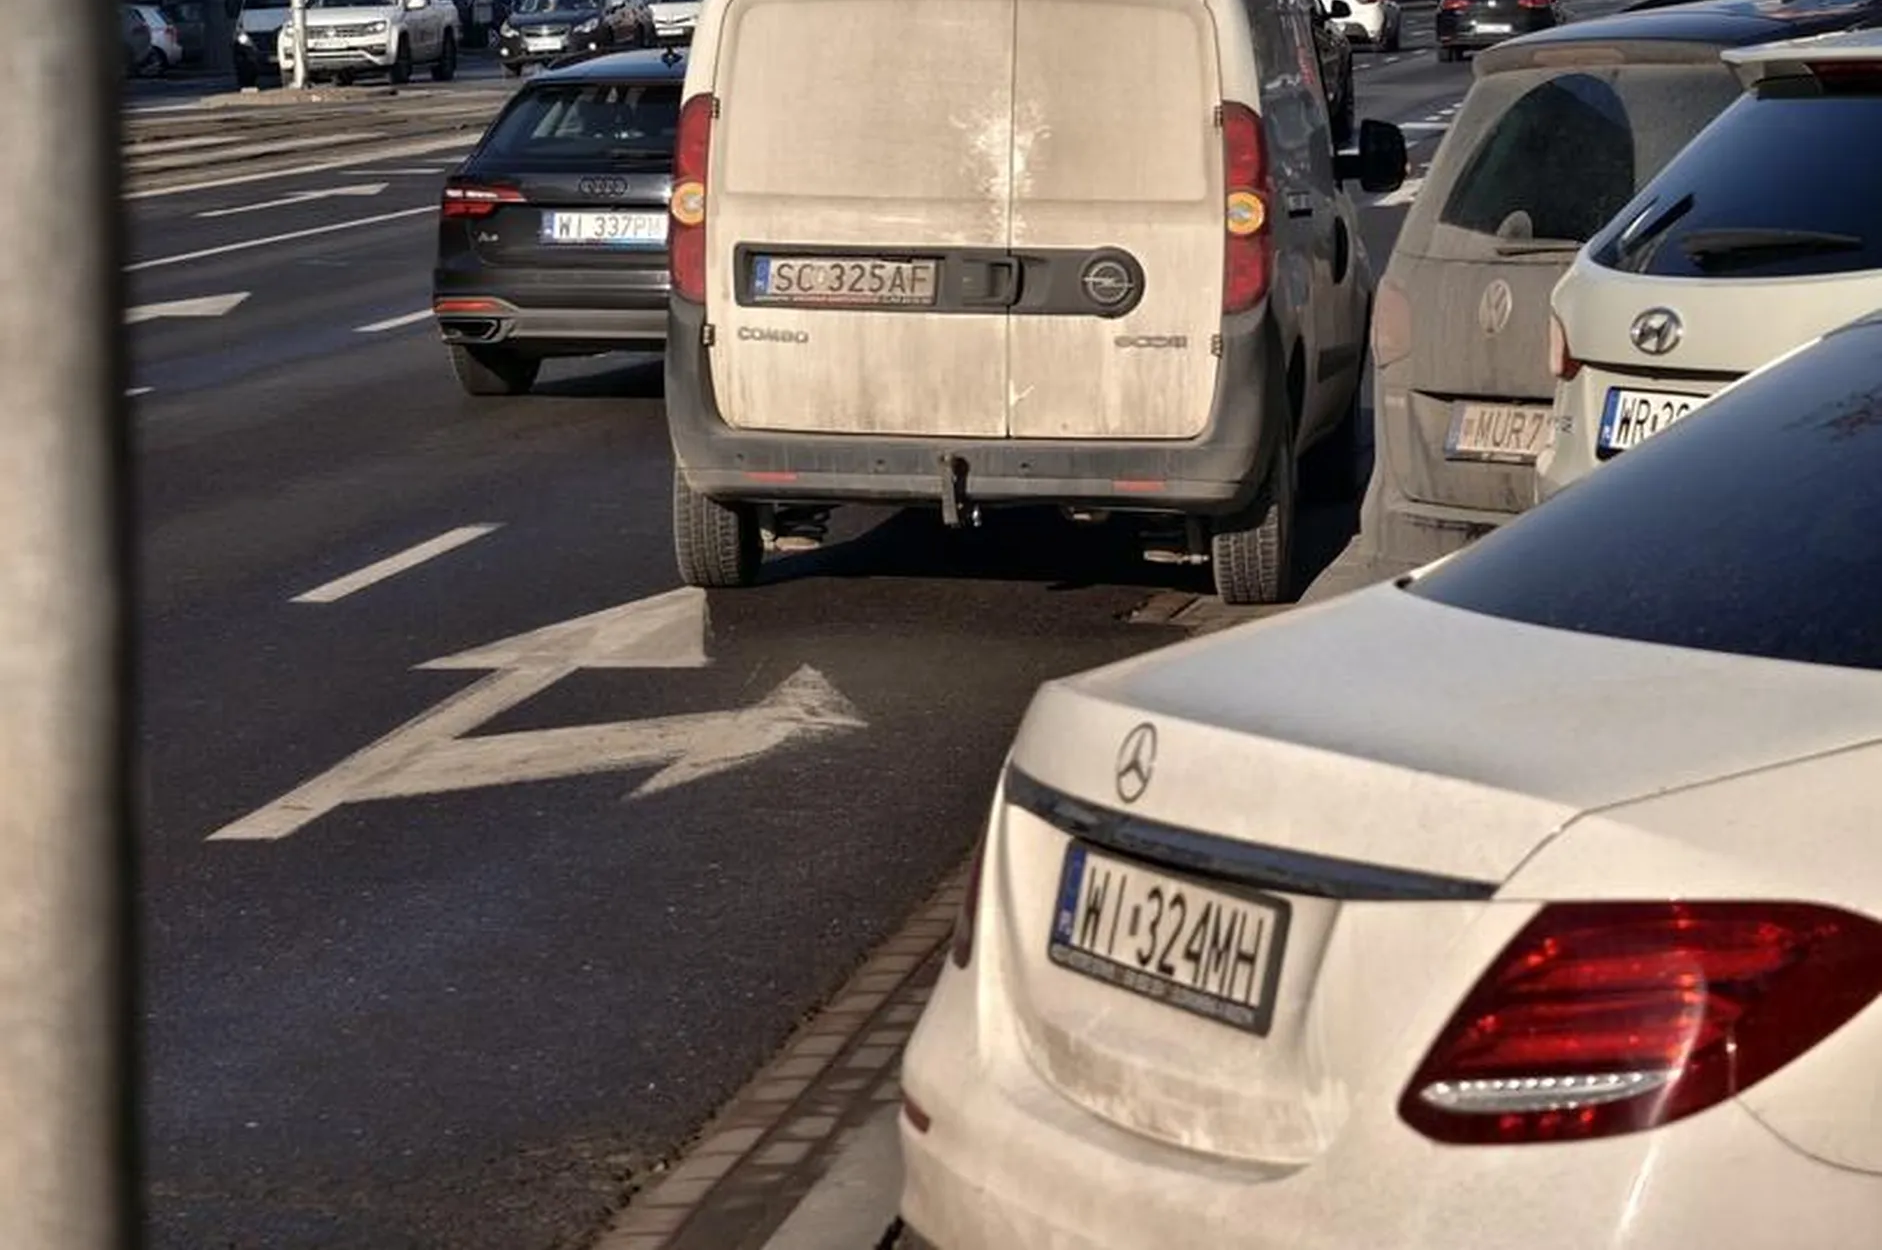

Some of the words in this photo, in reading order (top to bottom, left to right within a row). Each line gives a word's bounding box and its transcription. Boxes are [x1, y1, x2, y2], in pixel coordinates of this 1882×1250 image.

[559, 214, 582, 237] WI
[774, 263, 815, 293] SC
[828, 263, 930, 294] 325AF
[1616, 396, 1651, 447] WR
[1080, 866, 1128, 956] WI
[1136, 885, 1264, 1004] 324MH
